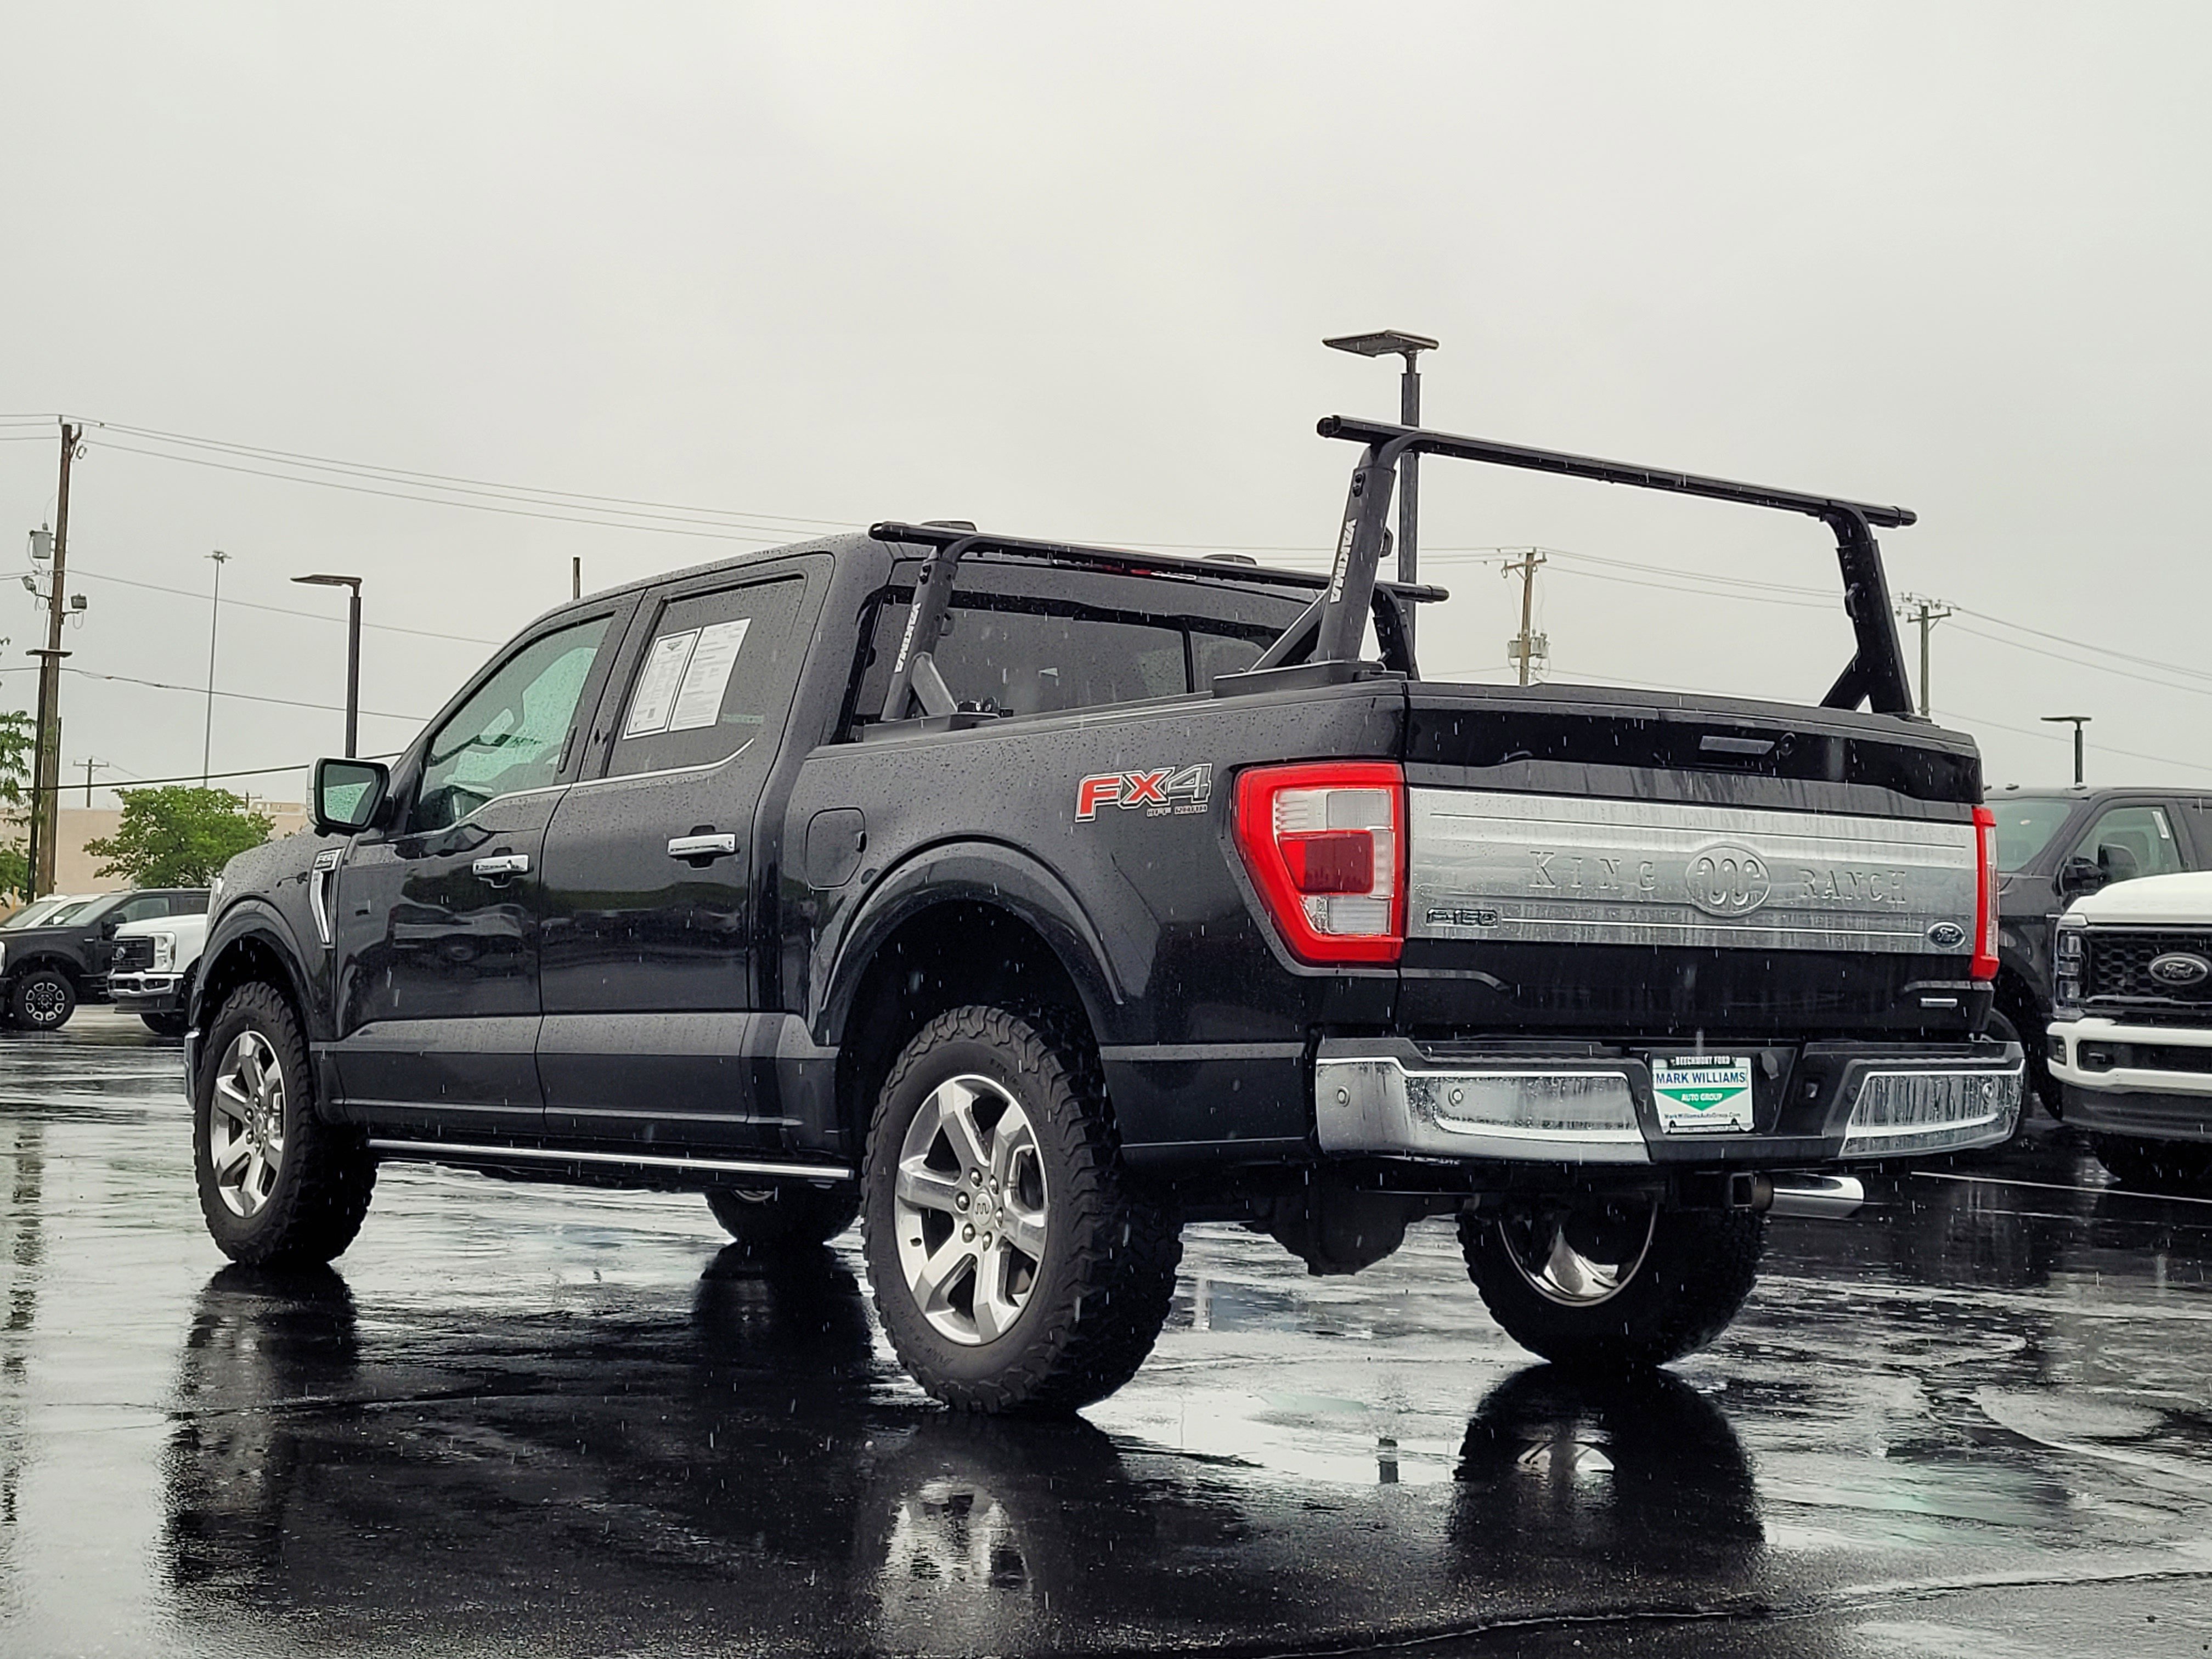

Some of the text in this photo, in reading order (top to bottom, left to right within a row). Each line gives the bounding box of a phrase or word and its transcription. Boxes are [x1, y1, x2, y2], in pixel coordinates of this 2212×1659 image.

[1330, 518, 1357, 603] YAKIMA
[894, 602, 921, 673] YAKIMA
[1075, 763, 1212, 822] FX4
[1529, 851, 1906, 904] KING RANCH
[1656, 1071, 1746, 1084] MARK WILLIAMS
[1681, 1093, 1723, 1102] AUTO GROUP
